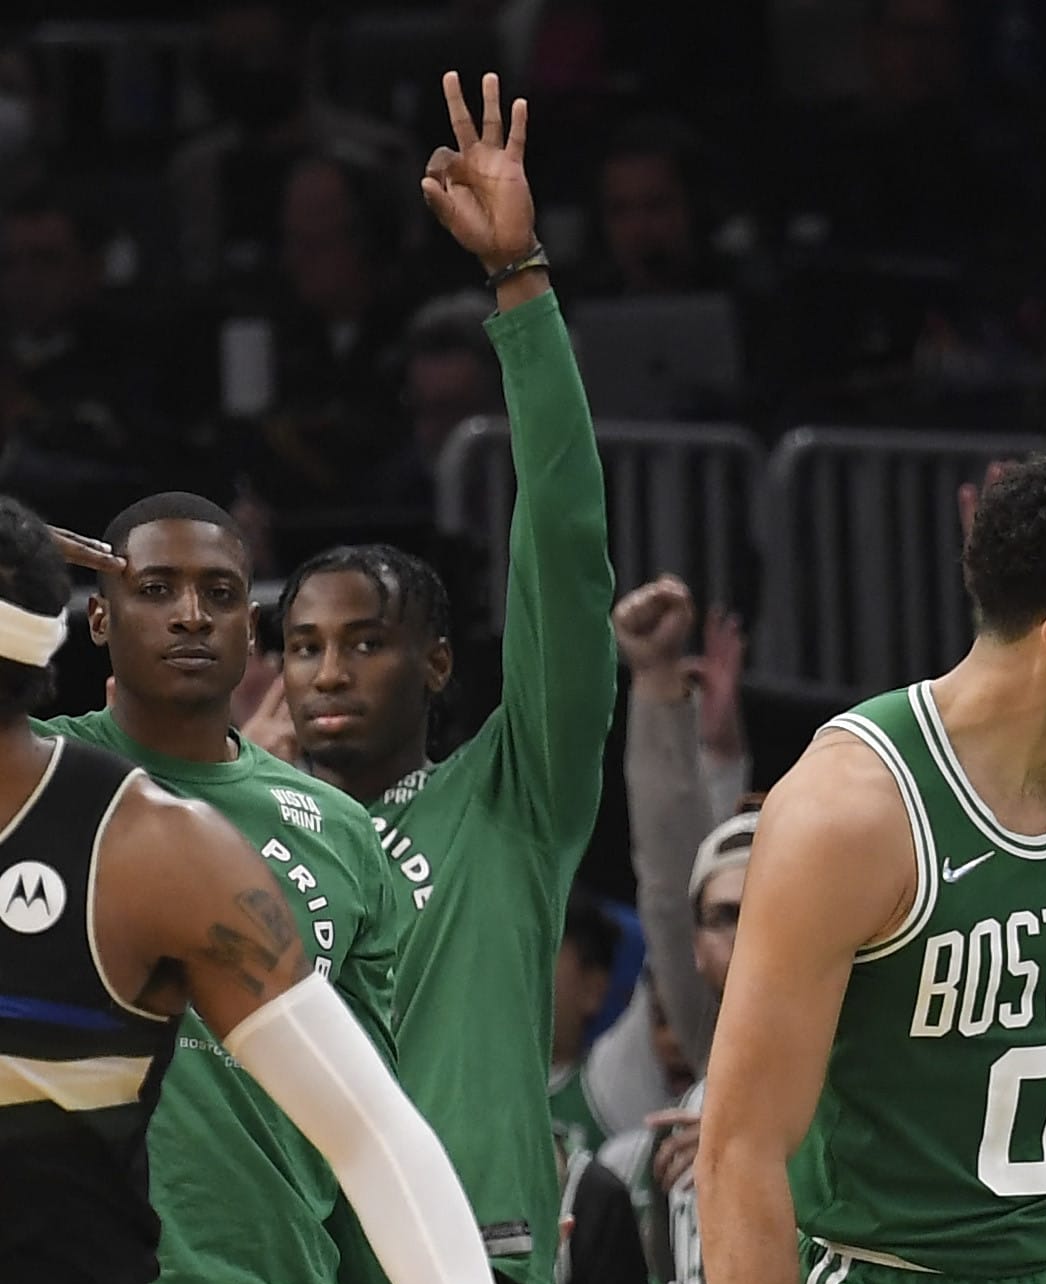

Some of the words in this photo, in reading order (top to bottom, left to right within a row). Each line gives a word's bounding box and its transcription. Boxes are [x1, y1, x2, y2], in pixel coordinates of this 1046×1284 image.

[269, 788, 320, 816] VISTA
[280, 804, 322, 833] PRINT
[260, 837, 336, 981] PRIDE
[180, 1037, 224, 1056] BOSTO
